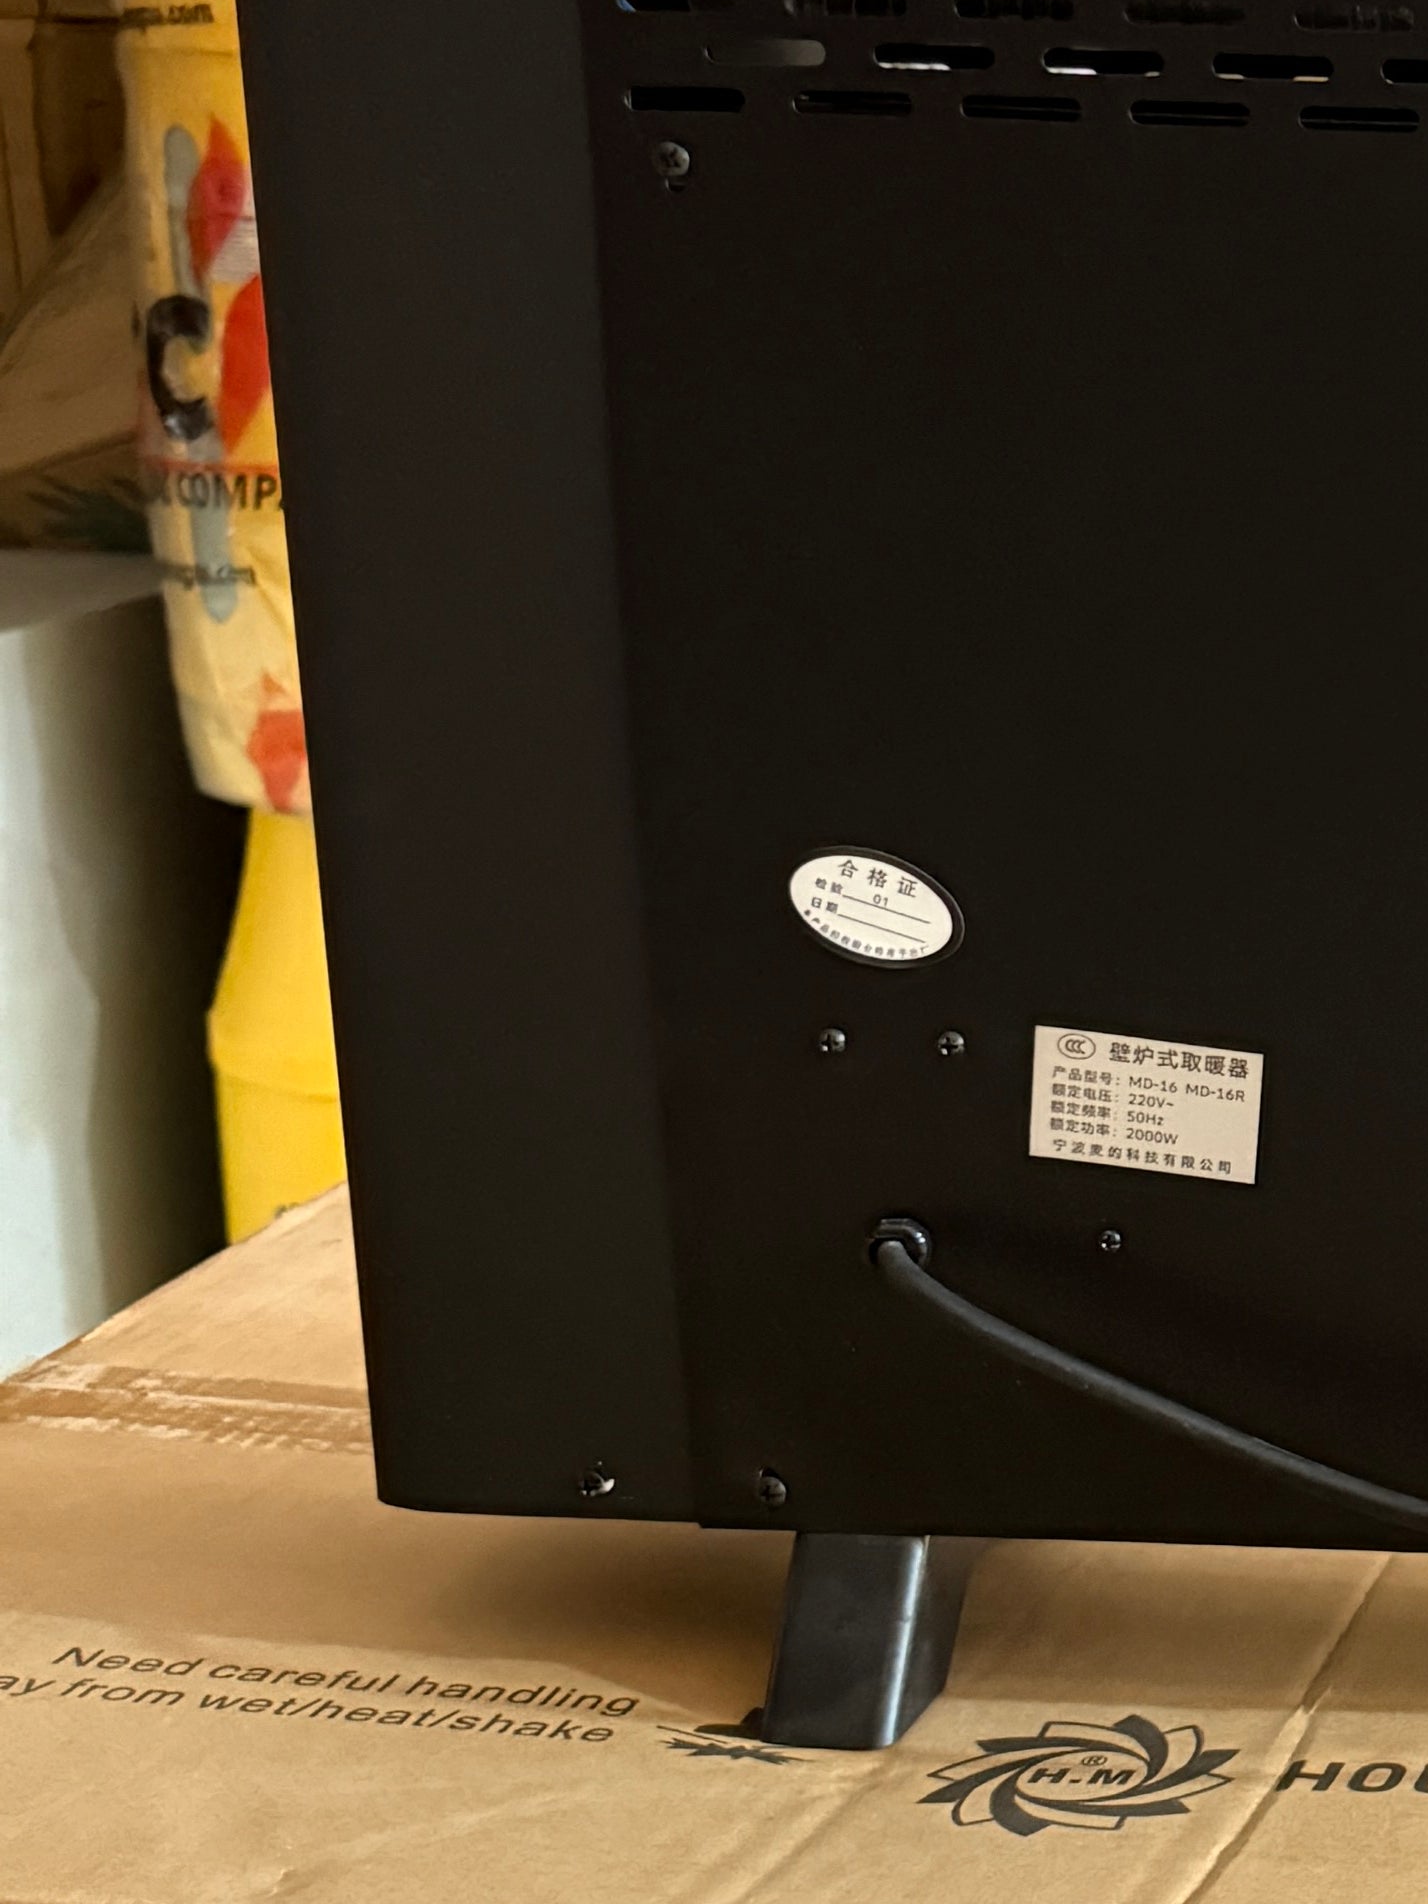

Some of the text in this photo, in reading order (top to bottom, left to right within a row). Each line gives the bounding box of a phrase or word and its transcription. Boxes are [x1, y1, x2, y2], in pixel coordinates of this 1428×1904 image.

[814, 877, 889, 907] 检验 01
[837, 859, 919, 898] 合格证
[810, 896, 839, 915] 日期
[1108, 1041, 1250, 1080] 壁炉式取暖器
[1128, 1076, 1178, 1094] MD-16
[1185, 1083, 1246, 1103] MD-16R
[1126, 1110, 1165, 1126] 50Hz
[1125, 1127, 1179, 1146] 2000W
[53, 1644, 641, 1720] Need careful handling
[68, 1676, 186, 1708] from
[199, 1691, 617, 1746] wet/heat/shake
